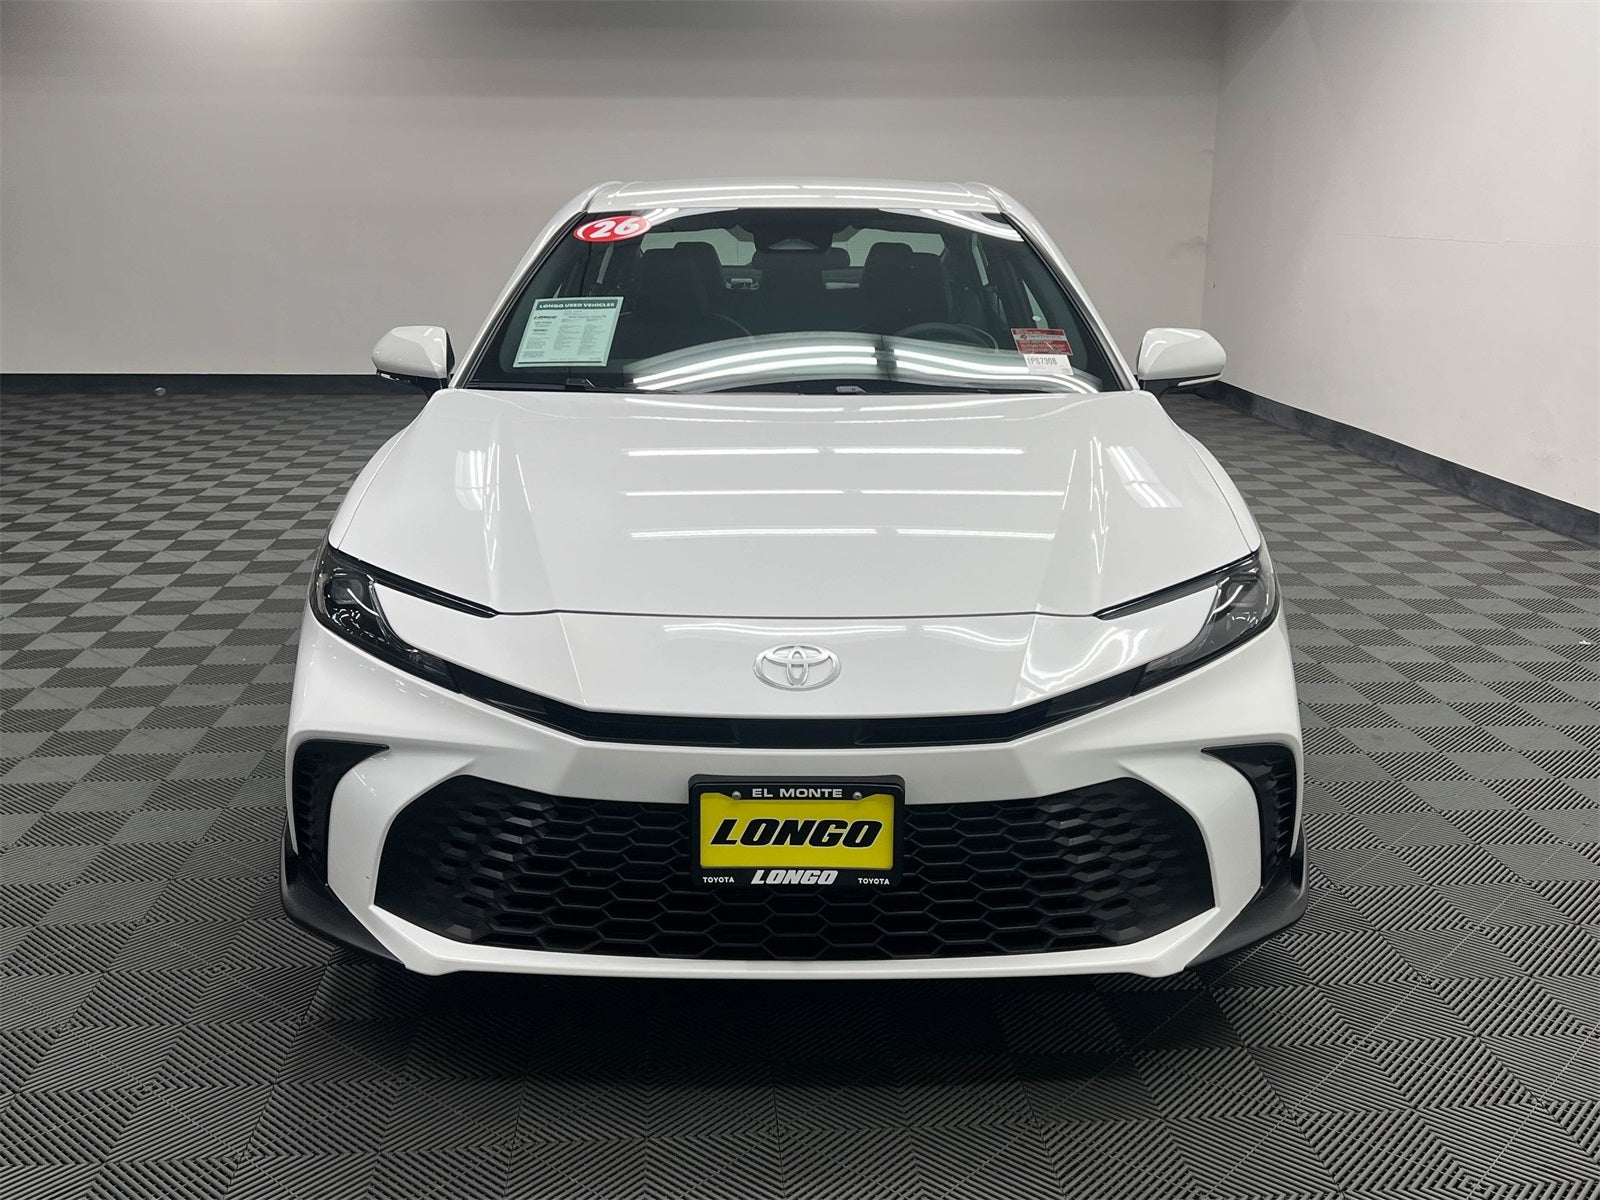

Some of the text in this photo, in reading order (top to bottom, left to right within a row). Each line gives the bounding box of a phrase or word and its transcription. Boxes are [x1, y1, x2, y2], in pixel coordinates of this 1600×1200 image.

[589, 217, 640, 238] 26
[752, 788, 843, 798] EL MONTE
[710, 818, 883, 848] LONGO
[751, 869, 839, 885] LONGO
[858, 877, 890, 885] TOYOTA
